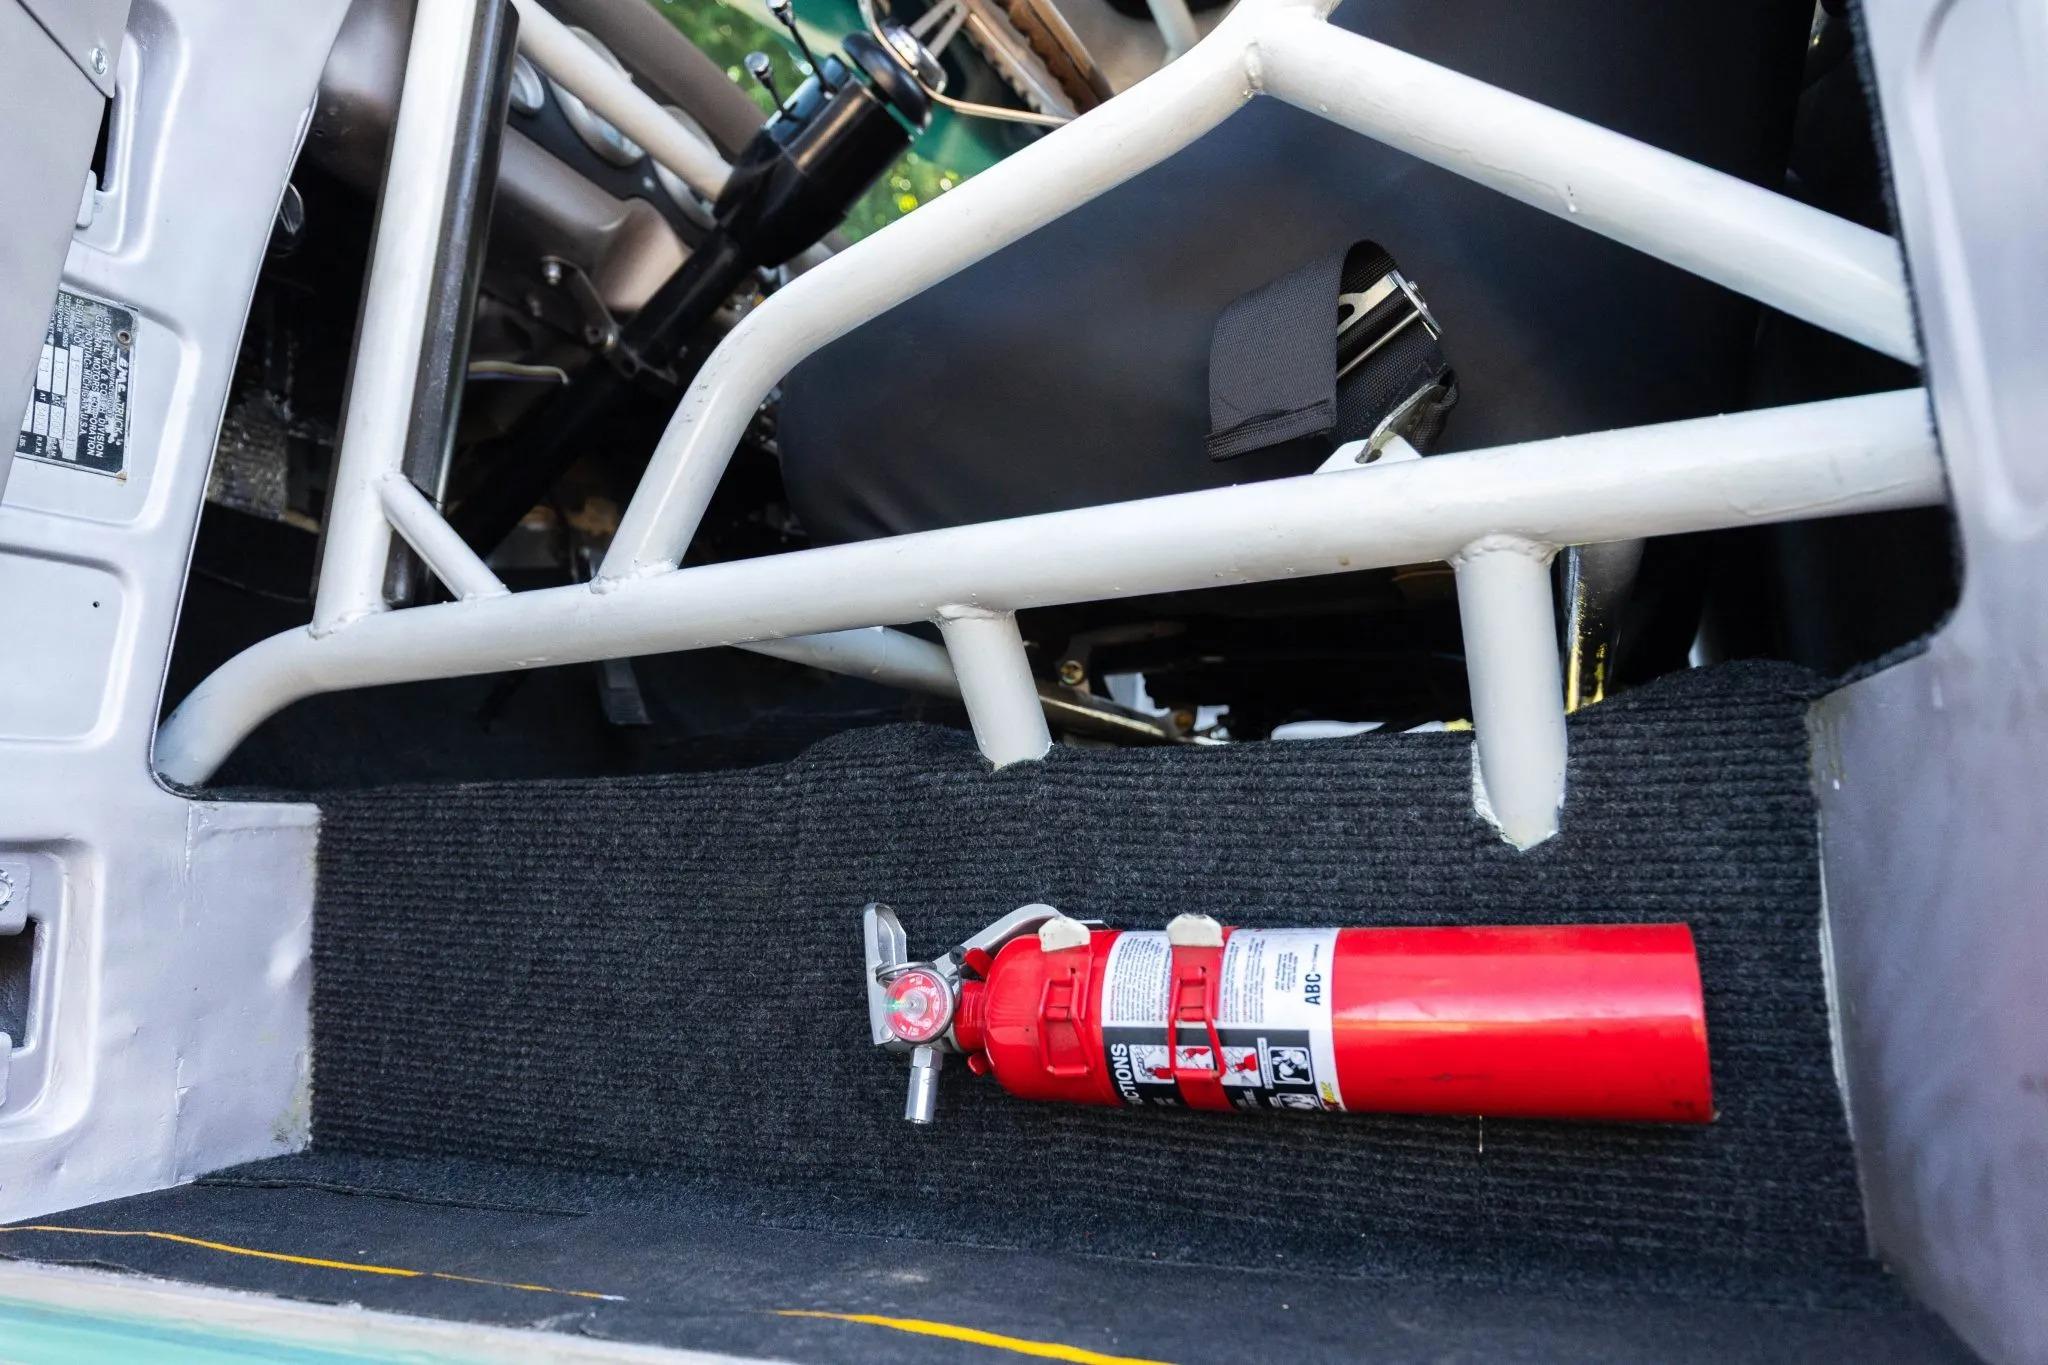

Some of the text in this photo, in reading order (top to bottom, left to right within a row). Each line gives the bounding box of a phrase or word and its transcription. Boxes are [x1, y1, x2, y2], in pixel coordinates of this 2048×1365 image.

[75, 298, 83, 328] SERIAL
[94, 315, 103, 353] GENERAL
[101, 373, 108, 381] &
[40, 392, 46, 401] AT
[87, 395, 99, 456] CORPORATION
[114, 401, 125, 434] TRUCK
[96, 418, 105, 457] DIVISION
[1305, 973, 1321, 1005] ABC
